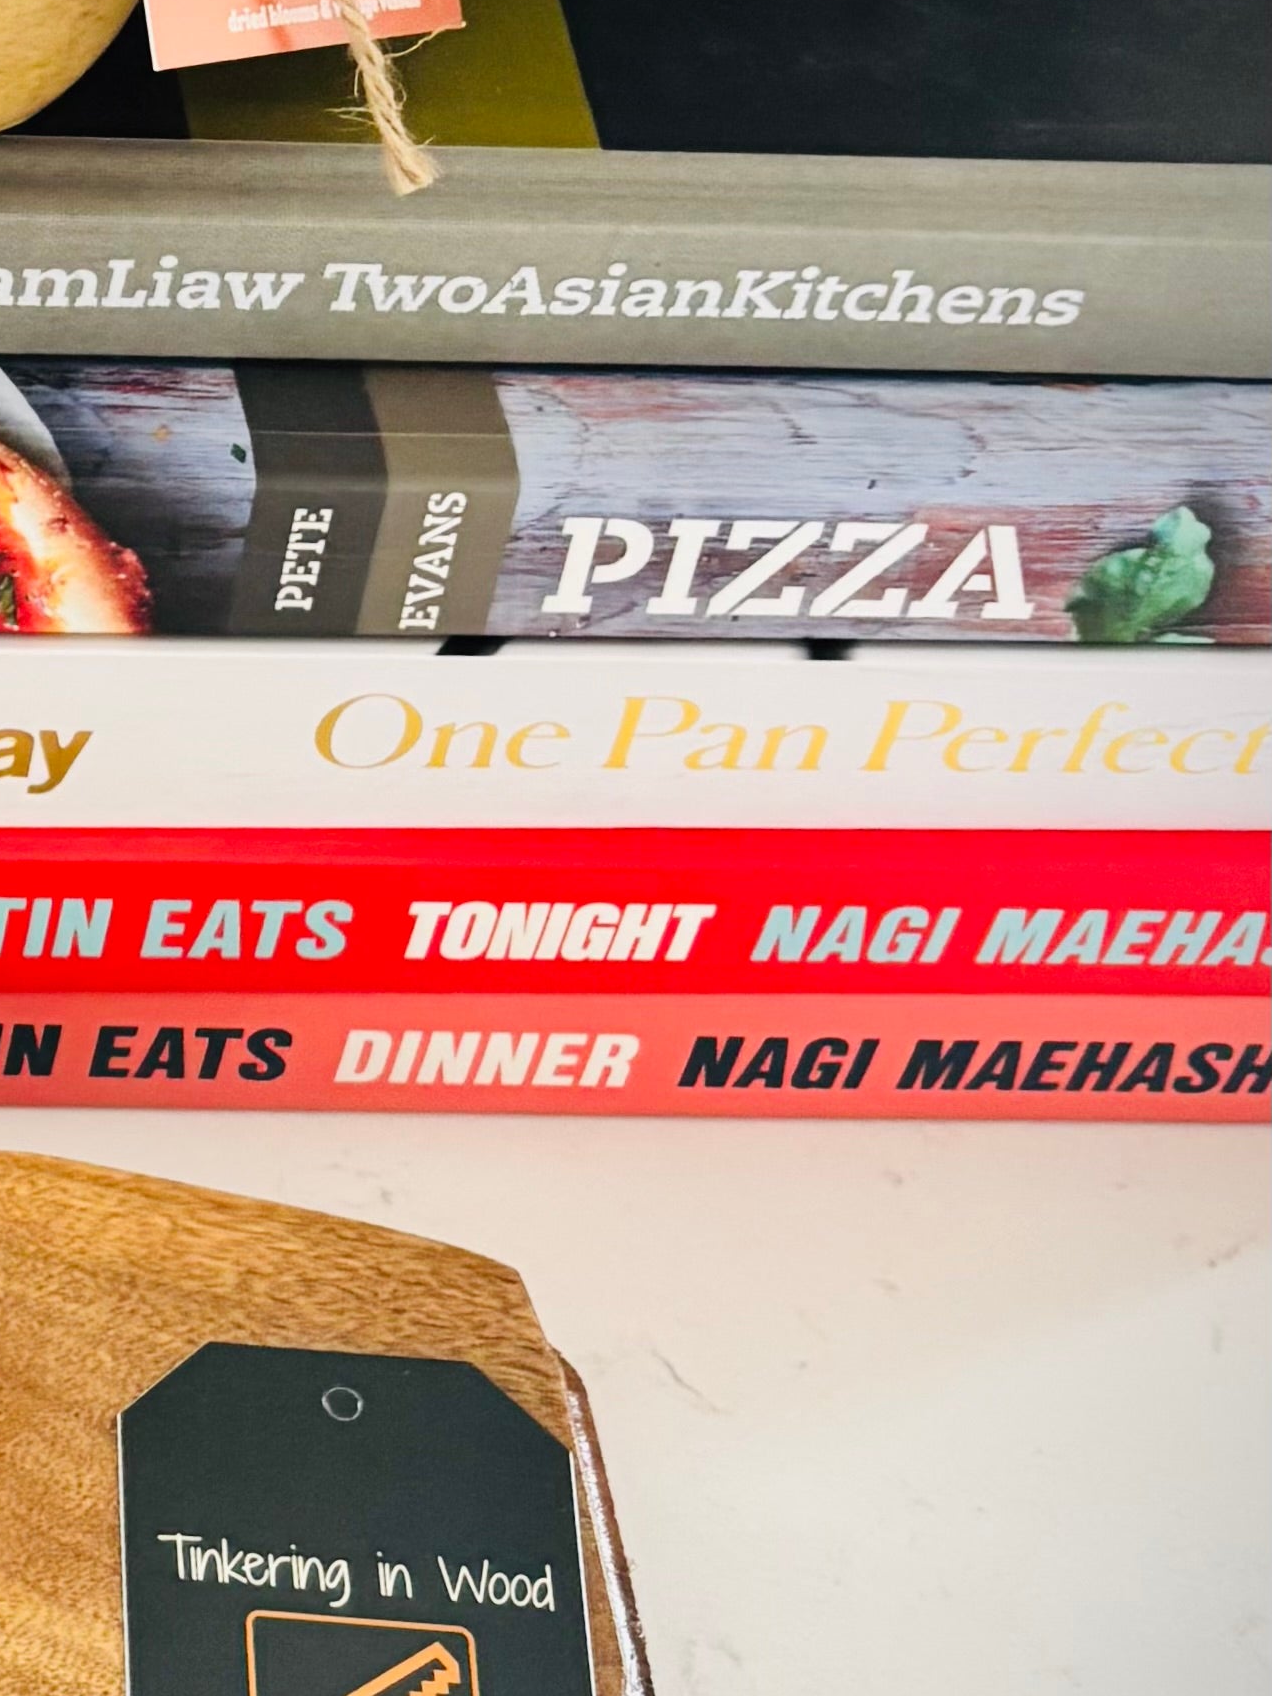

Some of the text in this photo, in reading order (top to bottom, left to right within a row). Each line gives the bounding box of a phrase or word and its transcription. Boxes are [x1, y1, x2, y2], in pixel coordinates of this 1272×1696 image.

[228, 4, 269, 33] dried
[322, 261, 1085, 327] TwoAsianKitchens
[274, 508, 334, 611] PETE
[398, 491, 468, 630] EVANS
[540, 515, 1035, 621] PIZZA
[314, 693, 1271, 777] One Pan Perfect
[140, 899, 354, 961] EATS
[404, 901, 717, 962] TONIGHT
[750, 905, 961, 965] NAGI
[974, 909, 1271, 967] MAEHA
[88, 1025, 293, 1082] EATS
[334, 1029, 640, 1088] DINNER
[678, 1035, 879, 1091] NAGI
[894, 1039, 1271, 1094] MAEHASH
[157, 1532, 557, 1613] Tinkering in Wood
